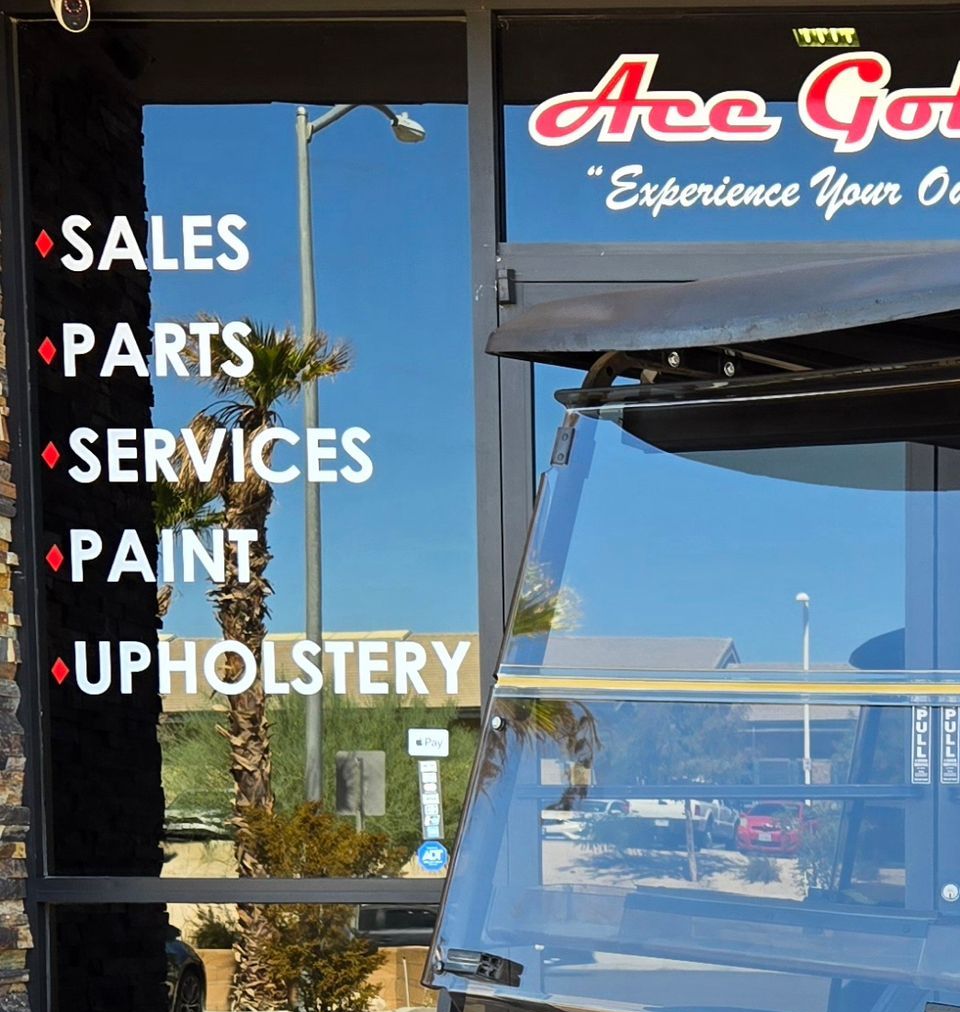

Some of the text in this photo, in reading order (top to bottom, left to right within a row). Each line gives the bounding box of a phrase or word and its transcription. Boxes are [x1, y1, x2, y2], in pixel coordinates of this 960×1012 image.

[528, 53, 783, 147] Ace
[809, 165, 904, 221] Your
[60, 214, 250, 272] SALES
[61, 321, 255, 378] PARTS
[67, 426, 374, 484] SERVICES
[69, 528, 259, 584] PAINT
[74, 640, 472, 696] UPHOLSTERY
[425, 737, 443, 750] Pay
[916, 708, 928, 758] PULL
[944, 708, 957, 758] PULL
